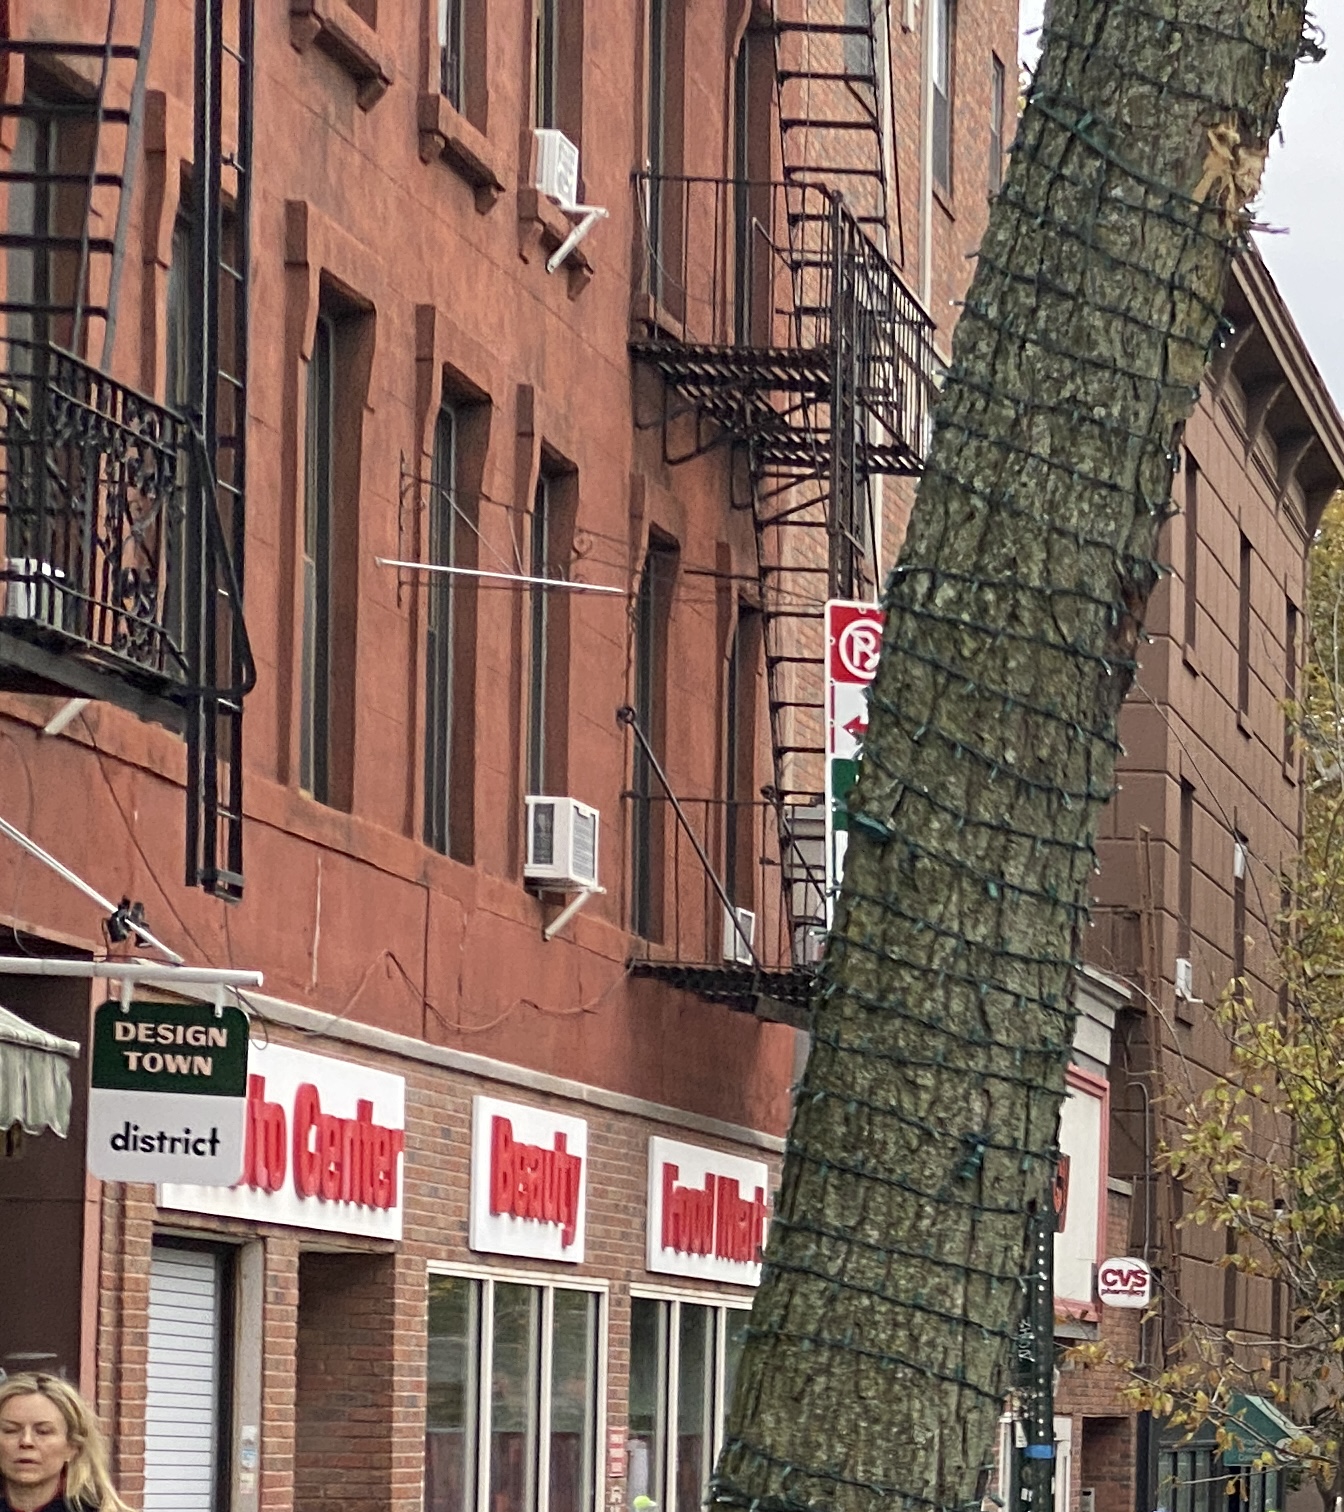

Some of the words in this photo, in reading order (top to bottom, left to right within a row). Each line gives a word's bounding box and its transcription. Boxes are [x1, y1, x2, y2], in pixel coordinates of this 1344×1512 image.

[114, 1021, 228, 1048] DESIGN
[123, 1051, 213, 1077] TOWN
[110, 1121, 221, 1157] district
[292, 1082, 405, 1210] Center
[490, 1114, 582, 1249] Beauty
[1101, 1268, 1147, 1288] CVS
